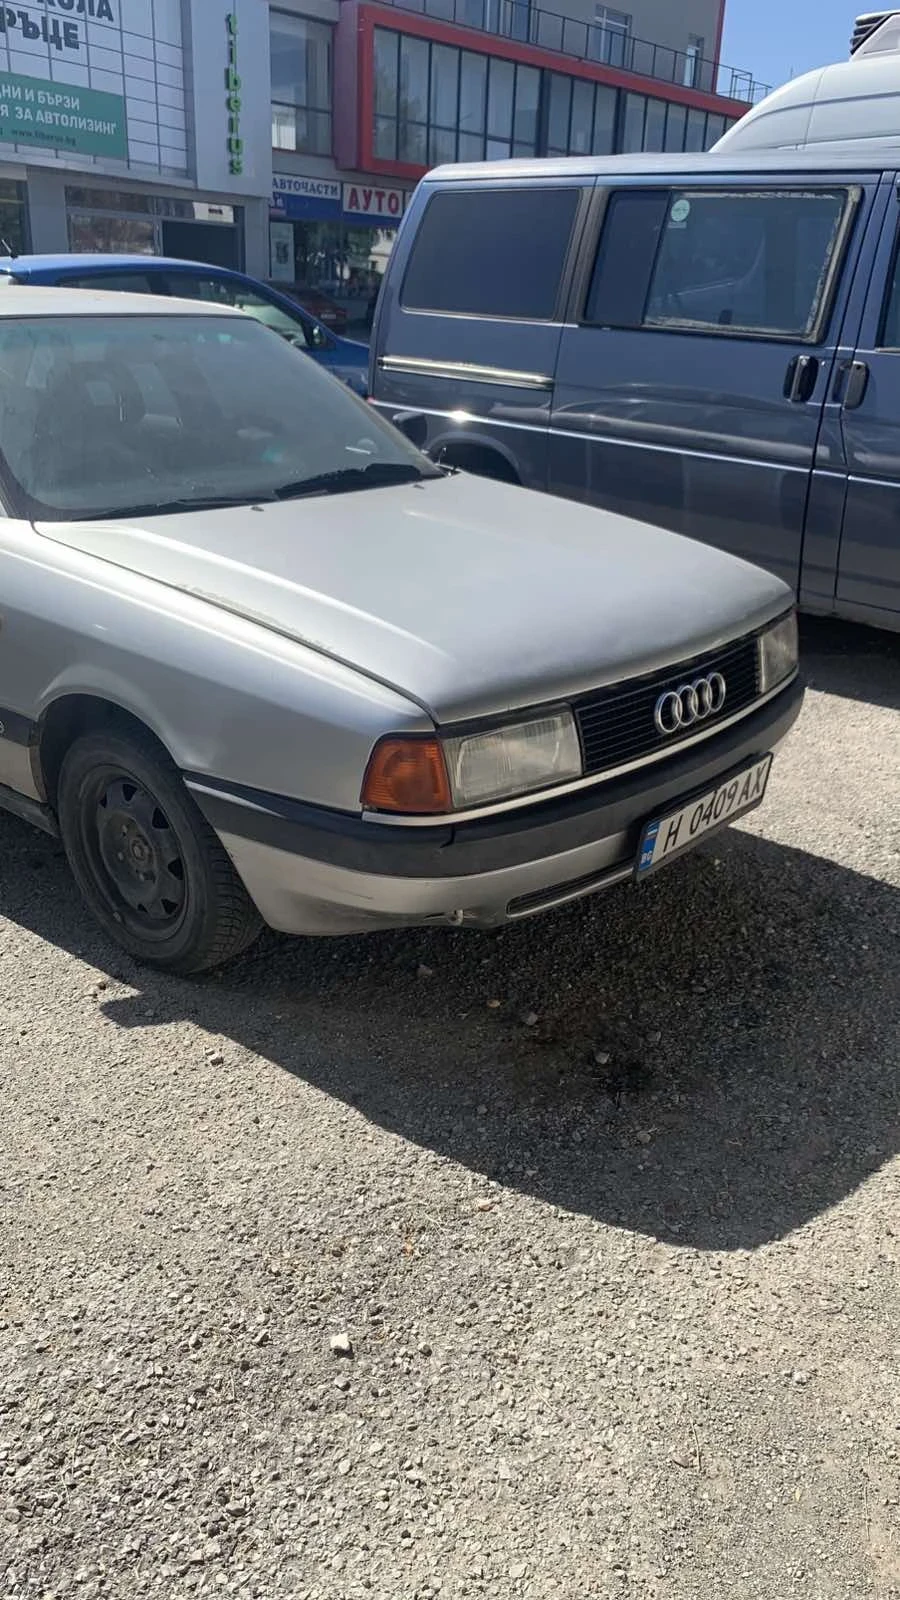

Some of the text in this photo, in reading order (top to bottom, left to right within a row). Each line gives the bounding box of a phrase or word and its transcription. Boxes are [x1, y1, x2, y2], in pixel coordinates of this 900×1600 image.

[0, 6, 80, 51] РЪЦЕ
[0, 84, 80, 111] НИ И БЪРЗИ
[225, 14, 243, 175] tiberus
[15, 106, 34, 121] ЗА
[36, 109, 117, 135] АВТОЛИЗИНГ
[271, 177, 339, 196] АВТОЧАСТИ
[347, 187, 400, 215] АУТО
[663, 761, 767, 853] H 0409 AX
